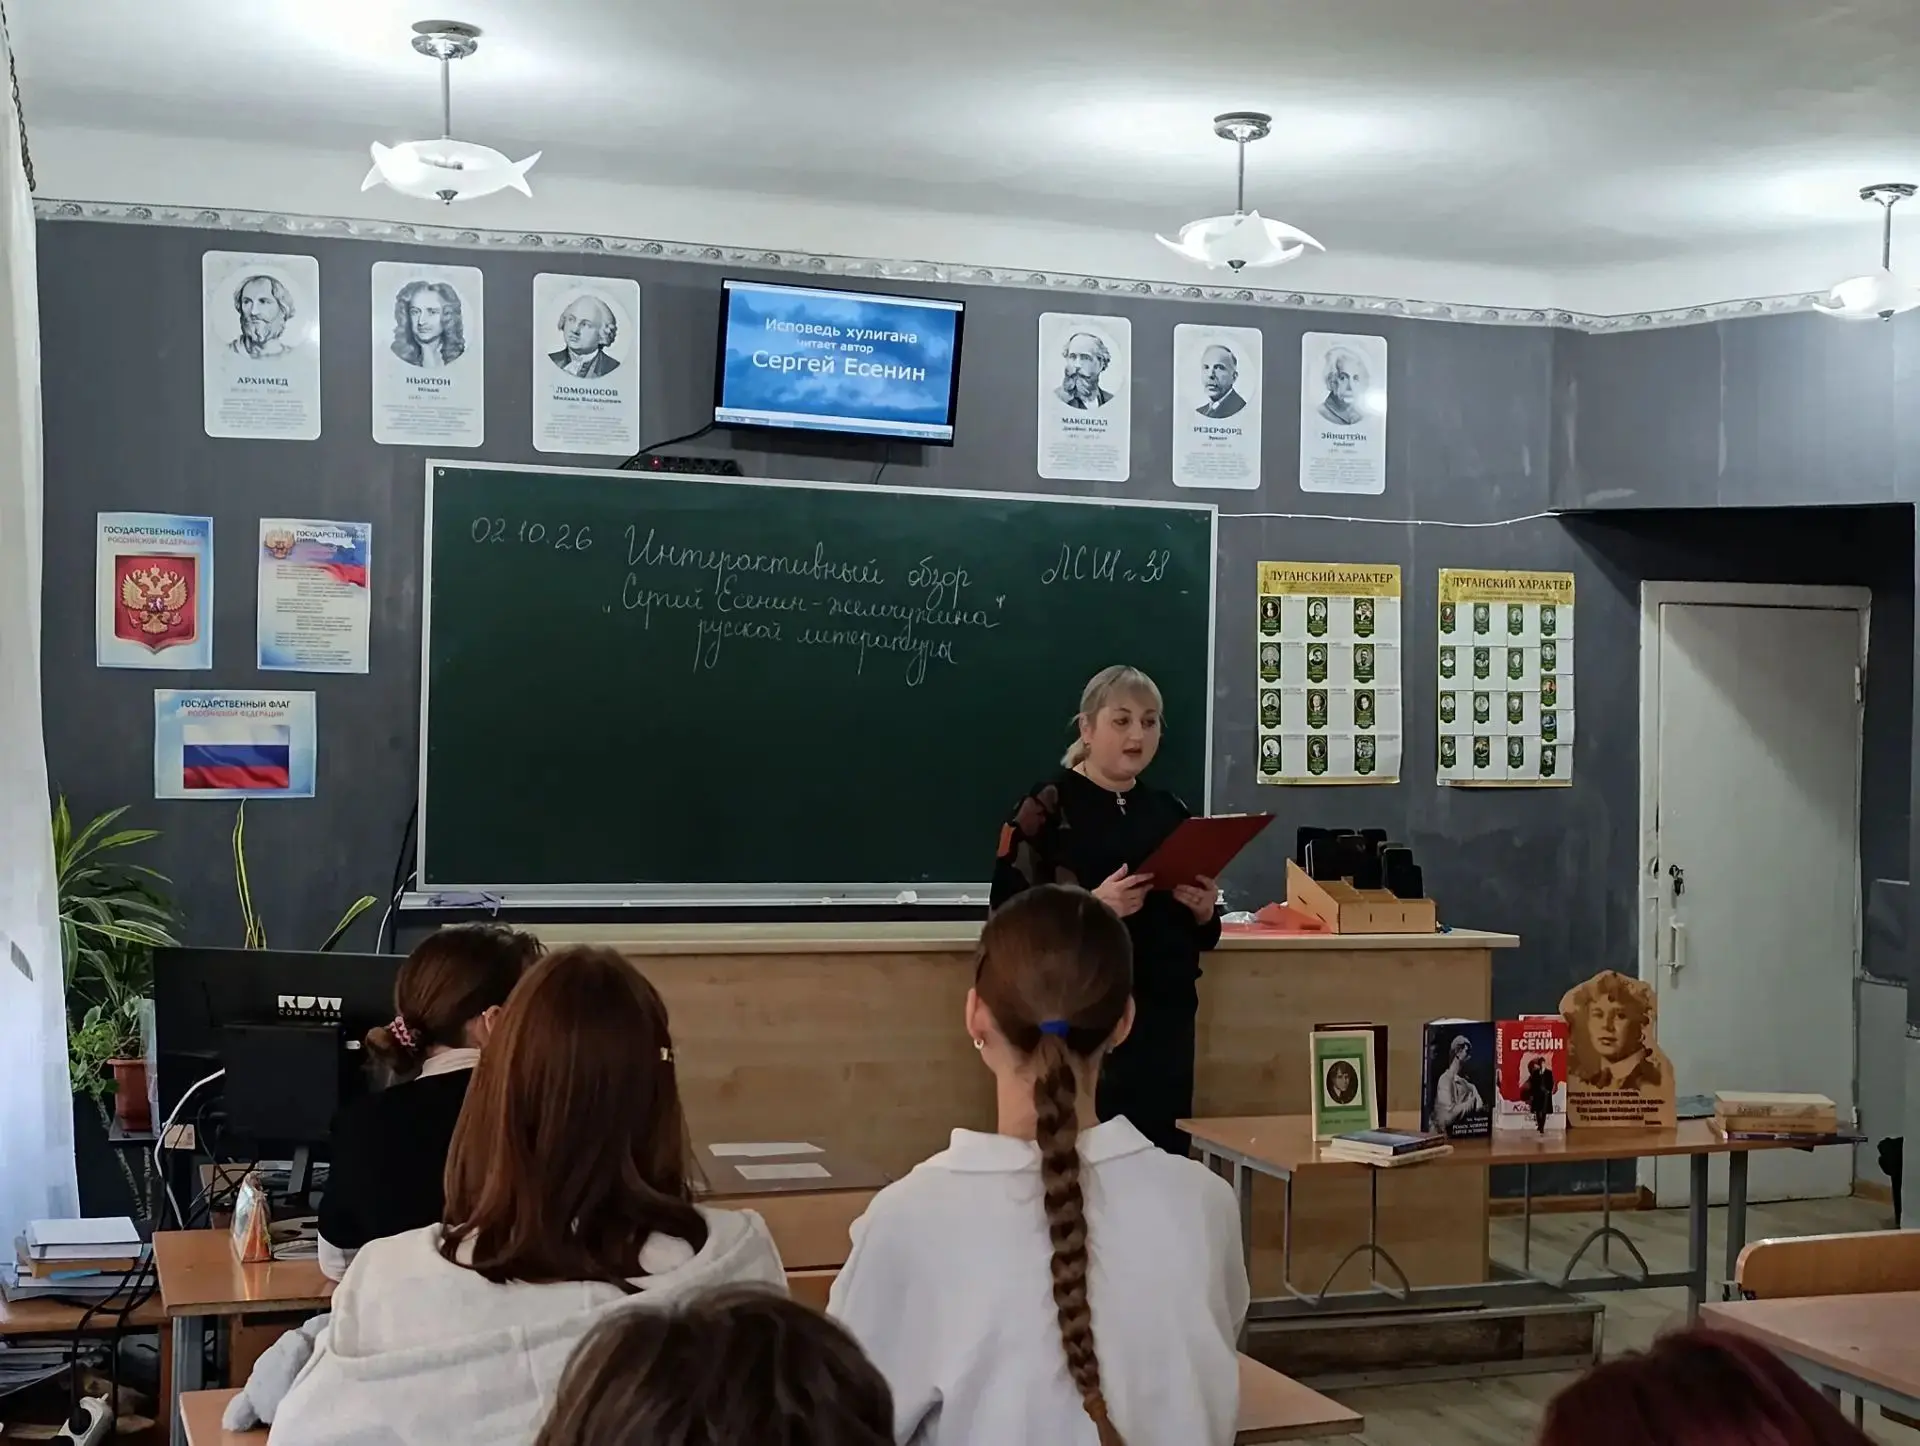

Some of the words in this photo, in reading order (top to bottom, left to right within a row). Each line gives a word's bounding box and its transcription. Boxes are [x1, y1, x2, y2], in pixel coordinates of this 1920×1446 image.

[764, 317, 841, 337] Исповедь
[846, 327, 918, 344] хулигана
[796, 338, 837, 350] читает
[840, 343, 874, 355] автор
[752, 350, 835, 374] Сергей
[844, 358, 925, 382] Есенин
[237, 376, 289, 387] АРХИМЕД
[405, 376, 451, 386] НЬЮТОН
[555, 386, 619, 397] ЛОМОНОСОВ
[1061, 417, 1108, 426] МАКСВЕЛЛ
[1193, 426, 1243, 436] РЕЗЕРФОРД
[1320, 431, 1367, 441] ЭЙНШТЕЙН
[104, 526, 185, 536] ГОСУДАРСТВЕННЫЙ
[624, 524, 884, 595] Интерактивный
[907, 555, 973, 610] обзор
[1269, 570, 1336, 582] ЛУГАНСКИЙ
[1338, 571, 1394, 583] ХАРАКТЕР
[1452, 577, 1516, 589] ЛУГАНСКИЙ
[1518, 578, 1572, 590] ХАРАКТЕР
[181, 699, 267, 708] ГОСУДАРСТВЕННЫЙ
[268, 700, 291, 708] ФЛАГ
[278, 995, 343, 1010] RDW
[1522, 1029, 1553, 1039] СЕРГЕЙ
[1511, 1038, 1564, 1051] ЕСЕНИН
